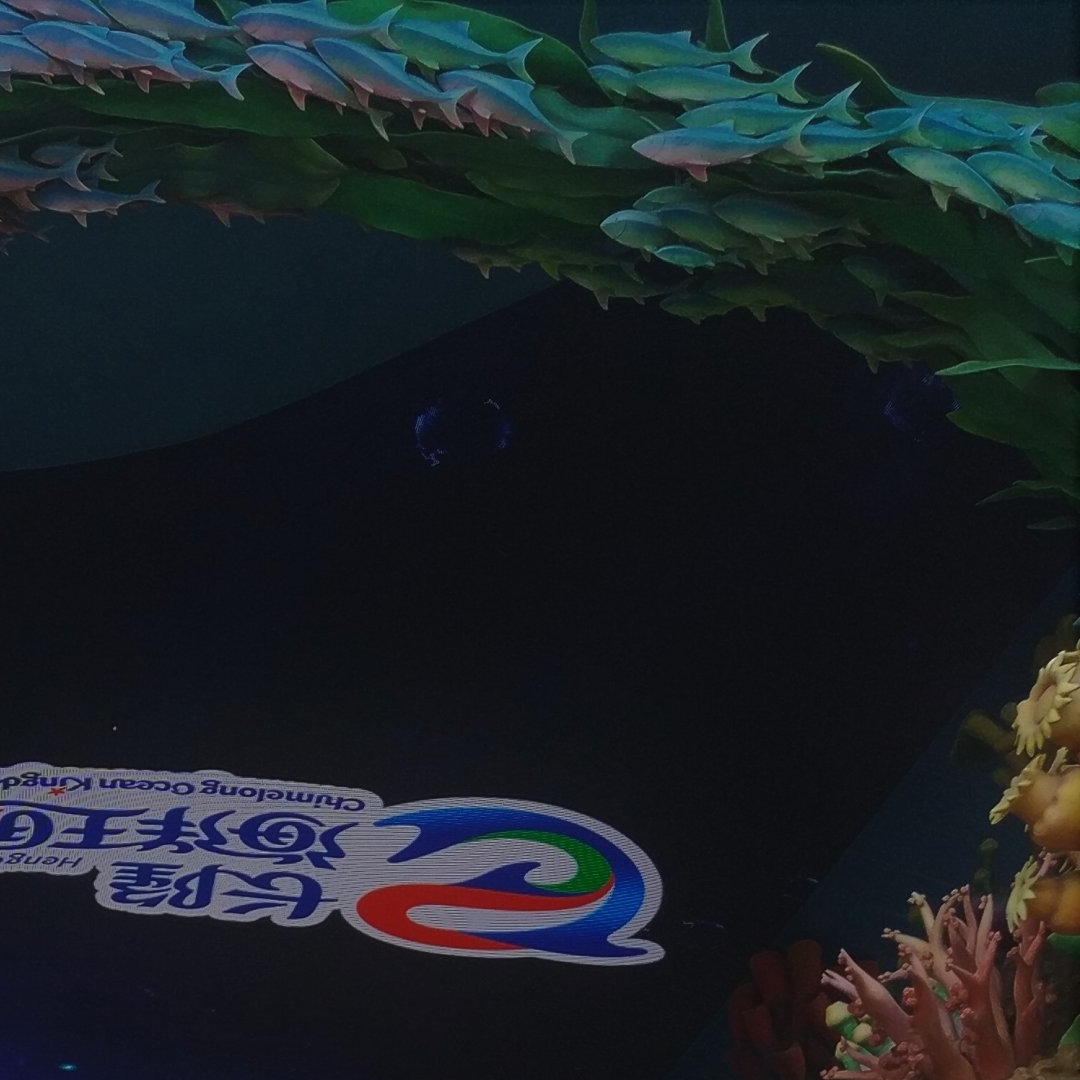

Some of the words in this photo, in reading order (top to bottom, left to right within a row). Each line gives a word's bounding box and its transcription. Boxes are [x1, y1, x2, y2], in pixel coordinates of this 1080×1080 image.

[100, 778, 195, 796] Ocean
[201, 780, 367, 813] Chimelong
[109, 861, 339, 920] 长隆
